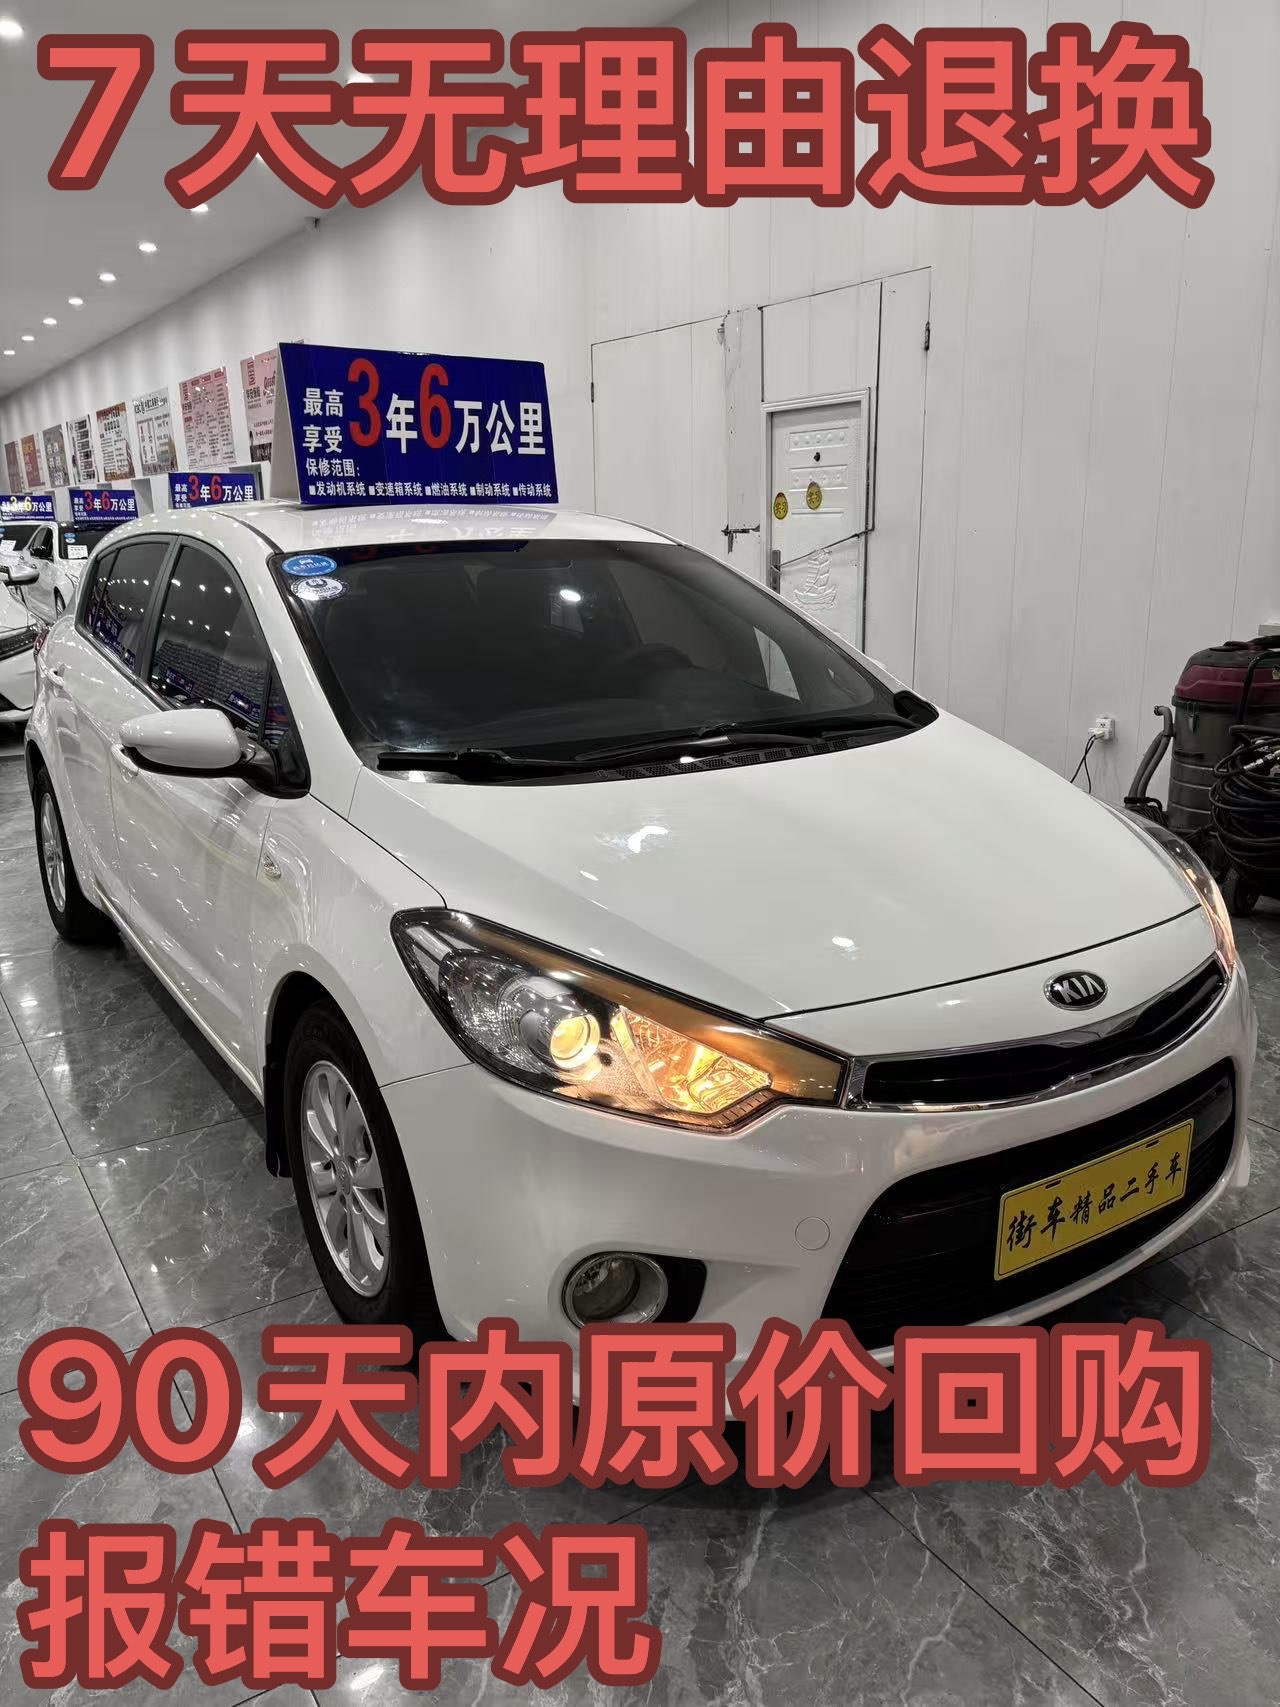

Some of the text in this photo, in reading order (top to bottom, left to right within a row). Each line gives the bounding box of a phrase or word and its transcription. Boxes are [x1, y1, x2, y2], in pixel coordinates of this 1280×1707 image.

[302, 387, 344, 418] 最高
[347, 357, 546, 456] 3年6万公里
[302, 424, 343, 454] 享受
[188, 474, 255, 502] 3年6万公里
[1056, 973, 1104, 1004] KIA
